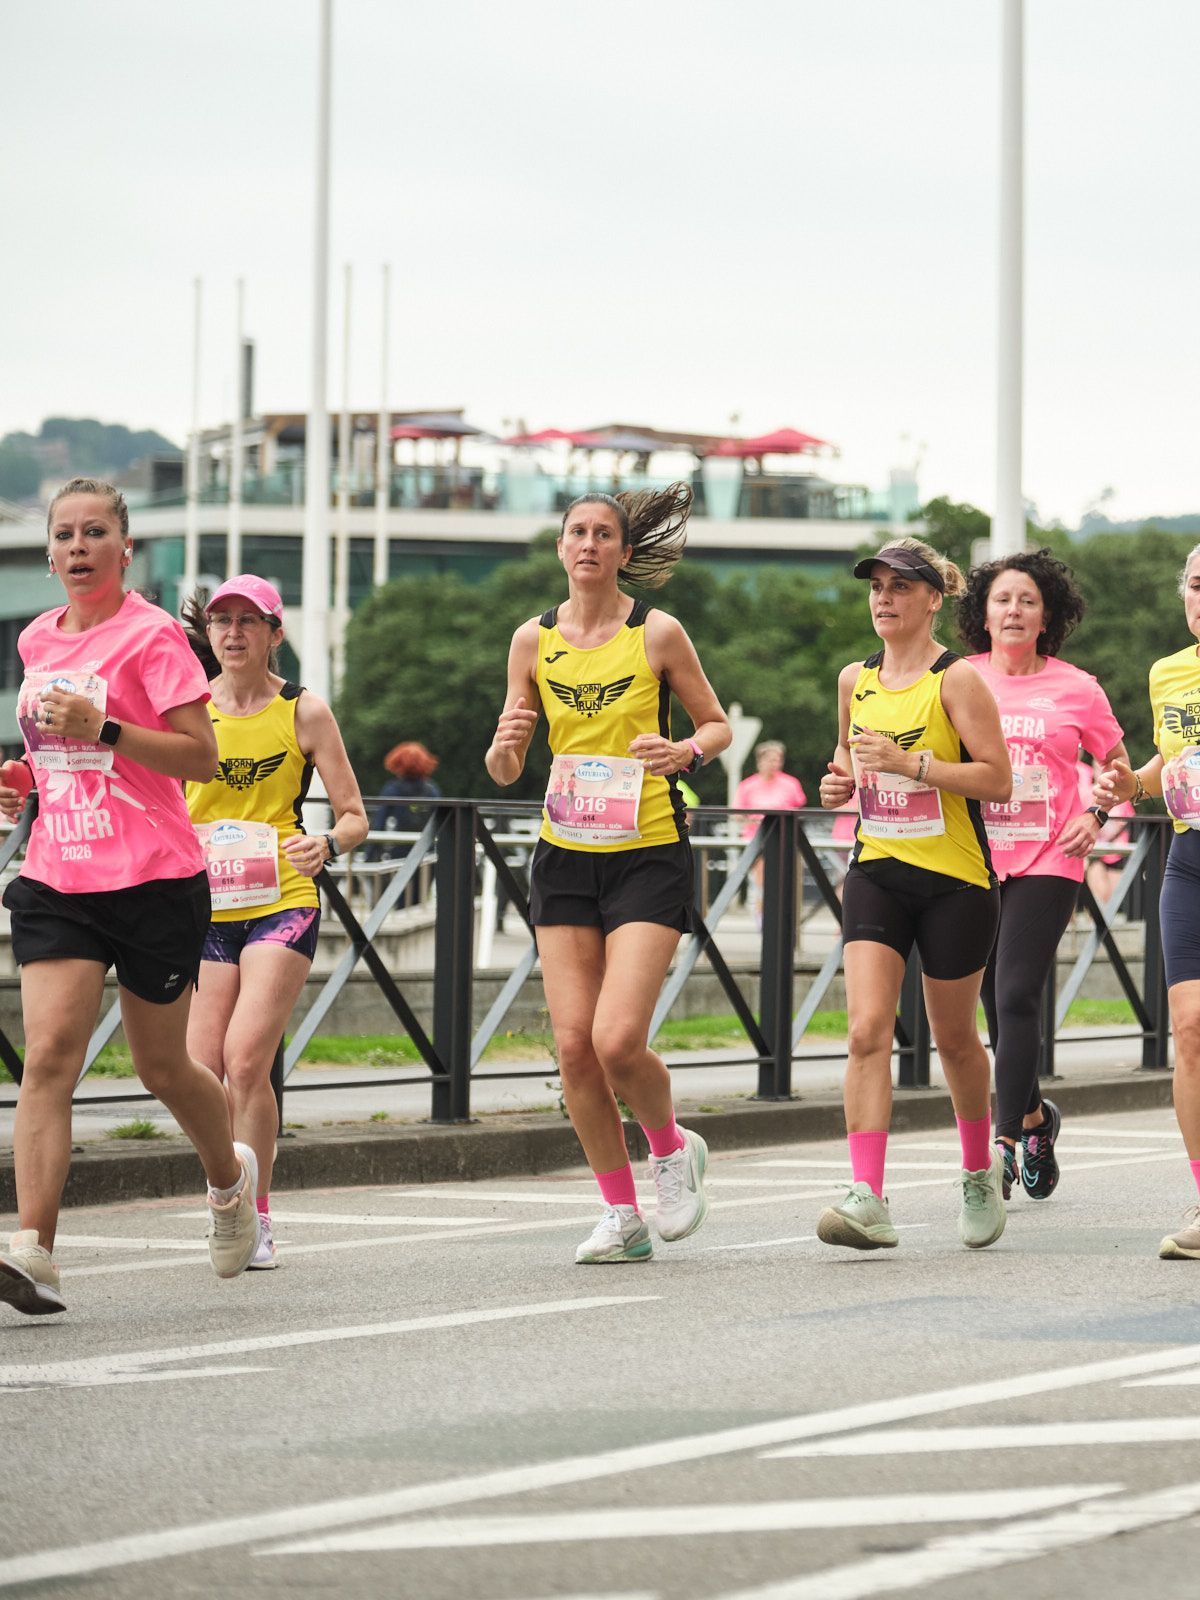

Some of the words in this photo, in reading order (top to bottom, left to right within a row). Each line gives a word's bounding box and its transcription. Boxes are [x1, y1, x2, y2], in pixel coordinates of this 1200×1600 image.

[578, 685, 600, 694] BORN
[579, 701, 600, 710] RUN
[1001, 714, 1046, 739] RERA
[228, 760, 251, 768] BORN
[228, 774, 251, 784] RUN
[574, 796, 607, 812] 016
[878, 791, 908, 807] 016
[989, 801, 1022, 814] 016
[61, 844, 92, 862] 2026
[210, 859, 245, 877] 016
